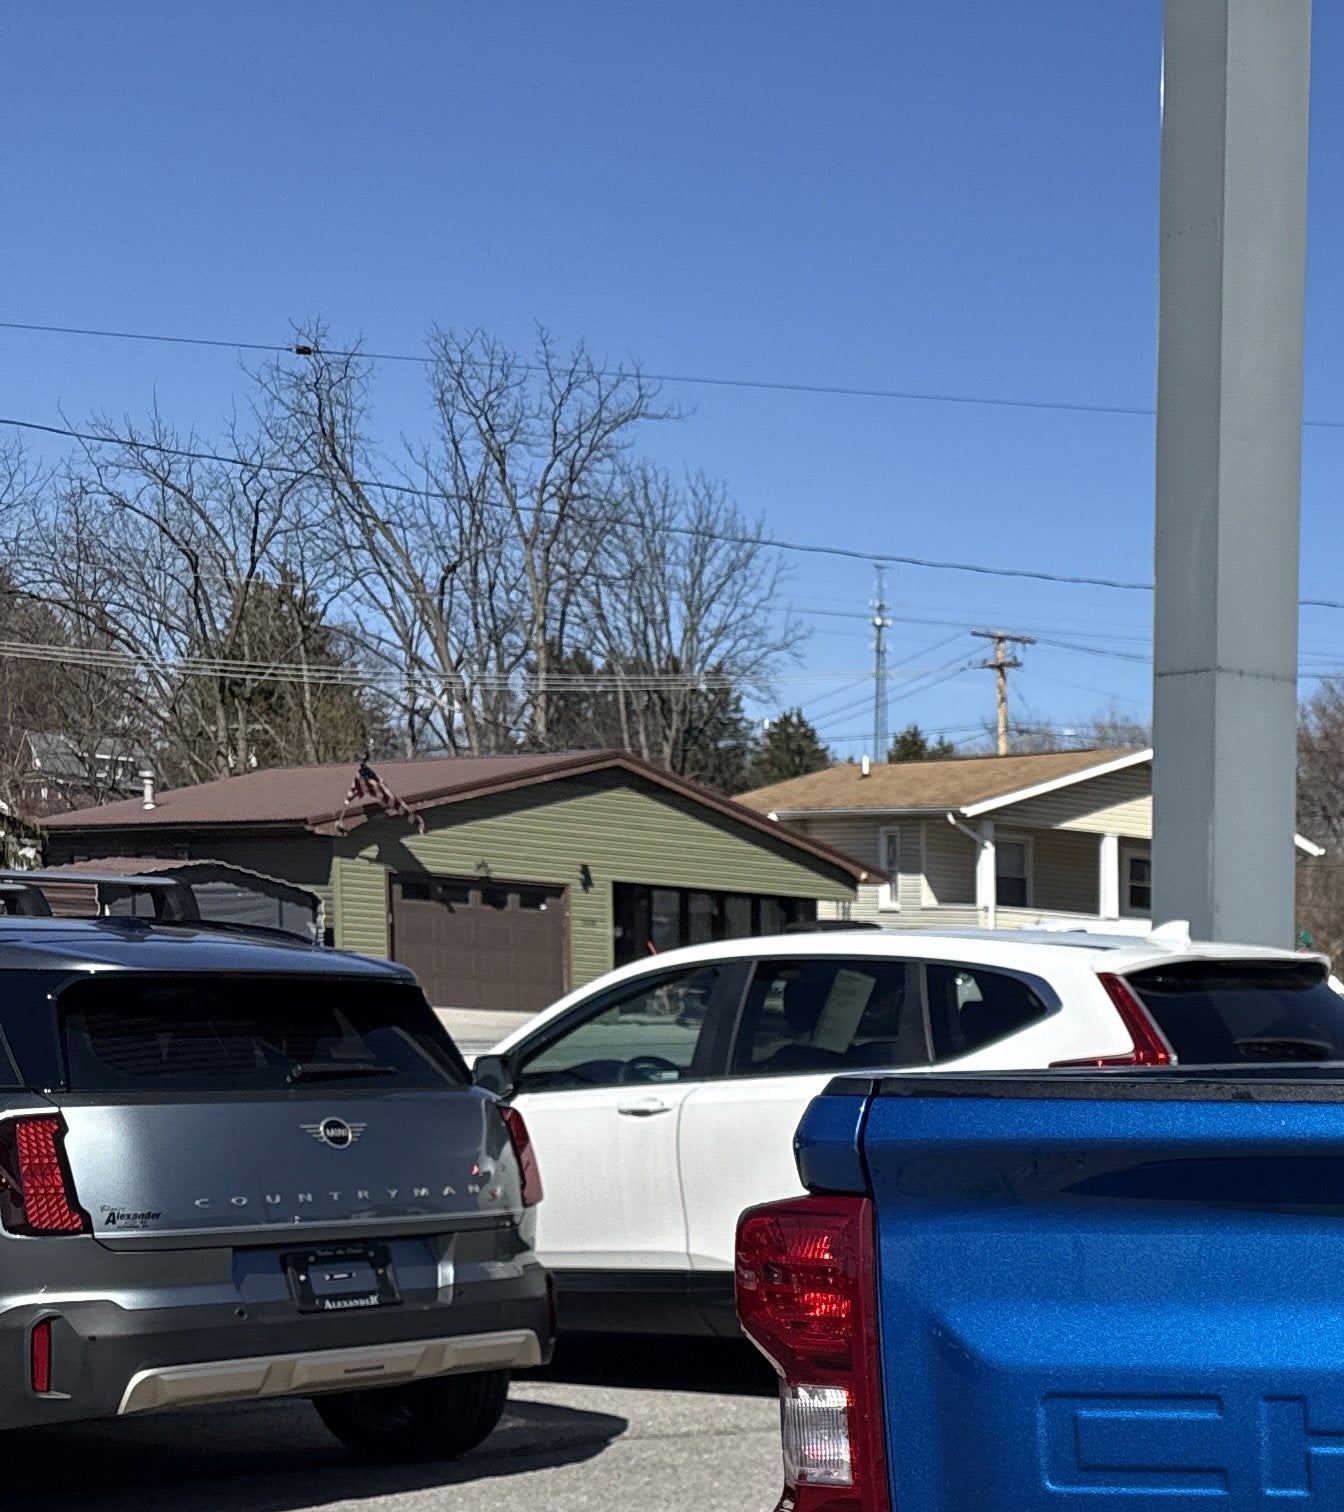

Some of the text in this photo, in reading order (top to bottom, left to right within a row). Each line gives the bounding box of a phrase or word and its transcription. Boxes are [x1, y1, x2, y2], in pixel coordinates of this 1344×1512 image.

[325, 1127, 348, 1137] MINI
[194, 1184, 480, 1208] COUNTRYMAN
[104, 1210, 162, 1226] Alexander
